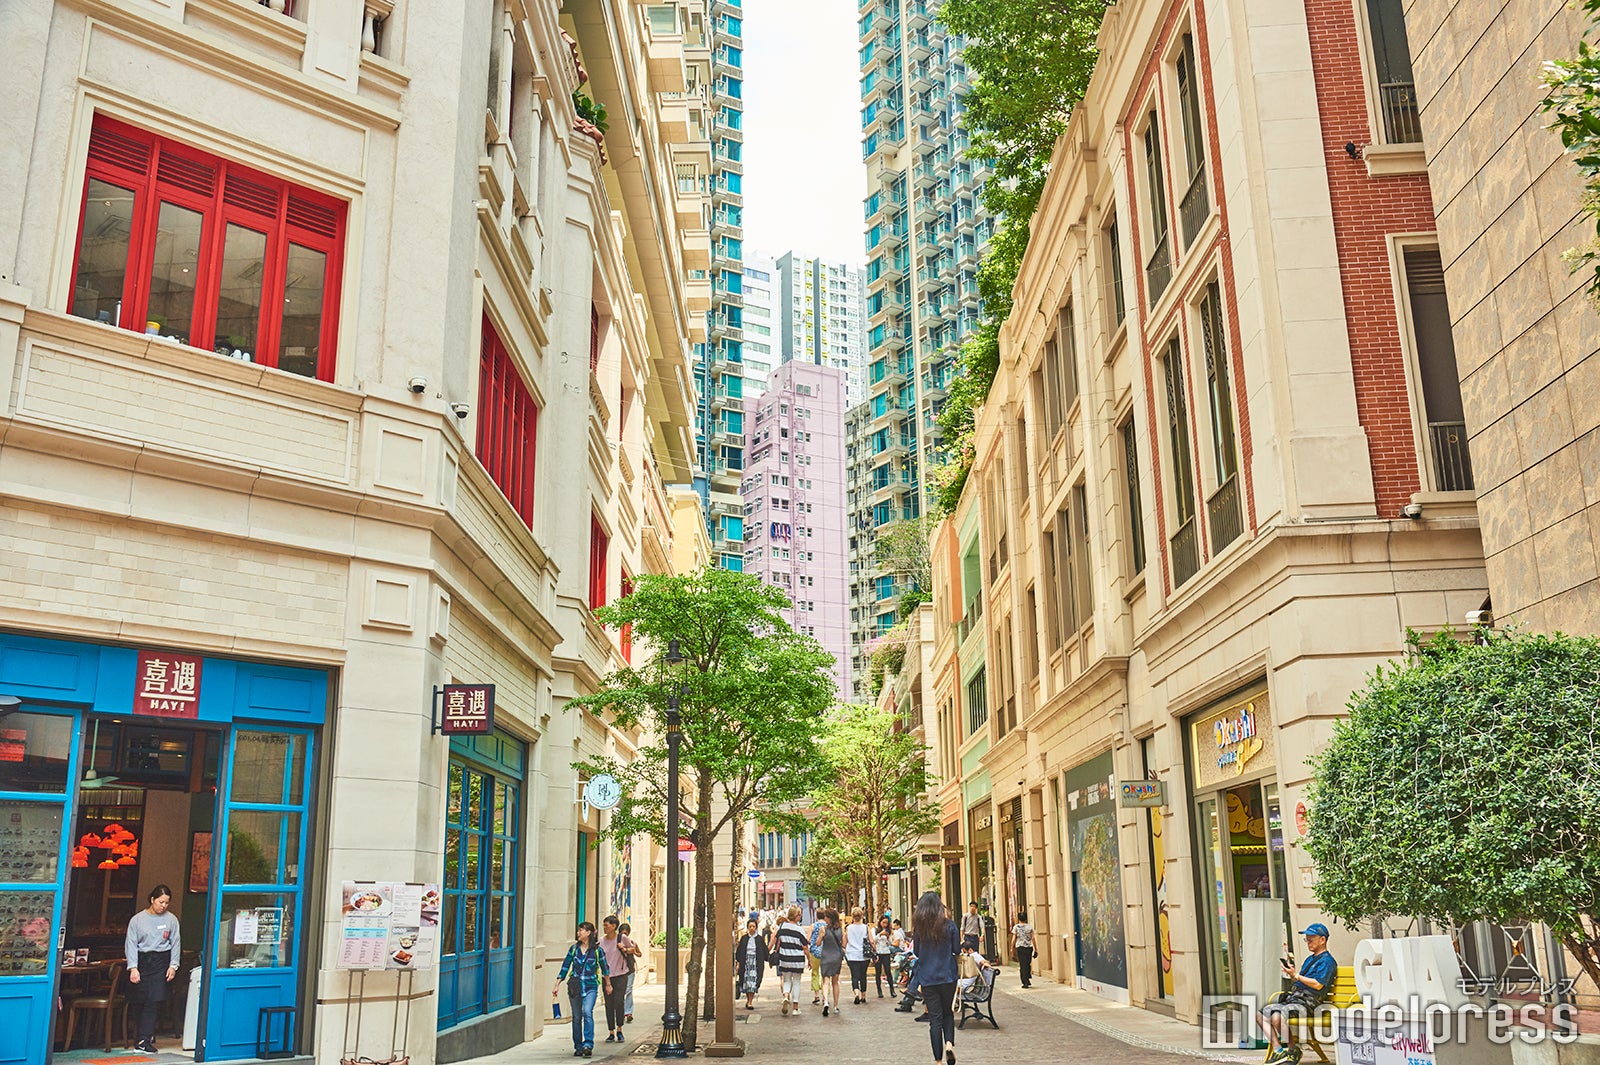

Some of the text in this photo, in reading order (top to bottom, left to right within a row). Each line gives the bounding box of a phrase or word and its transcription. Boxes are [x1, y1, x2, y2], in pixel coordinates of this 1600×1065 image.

[143, 658, 195, 694] 喜遇
[150, 699, 185, 711] HAY!
[447, 690, 486, 715] 喜遇
[453, 720, 478, 728] HAY!
[1214, 702, 1257, 749] Okashi
[1122, 783, 1157, 794] Okashi
[1391, 1032, 1432, 1058] citywalk
